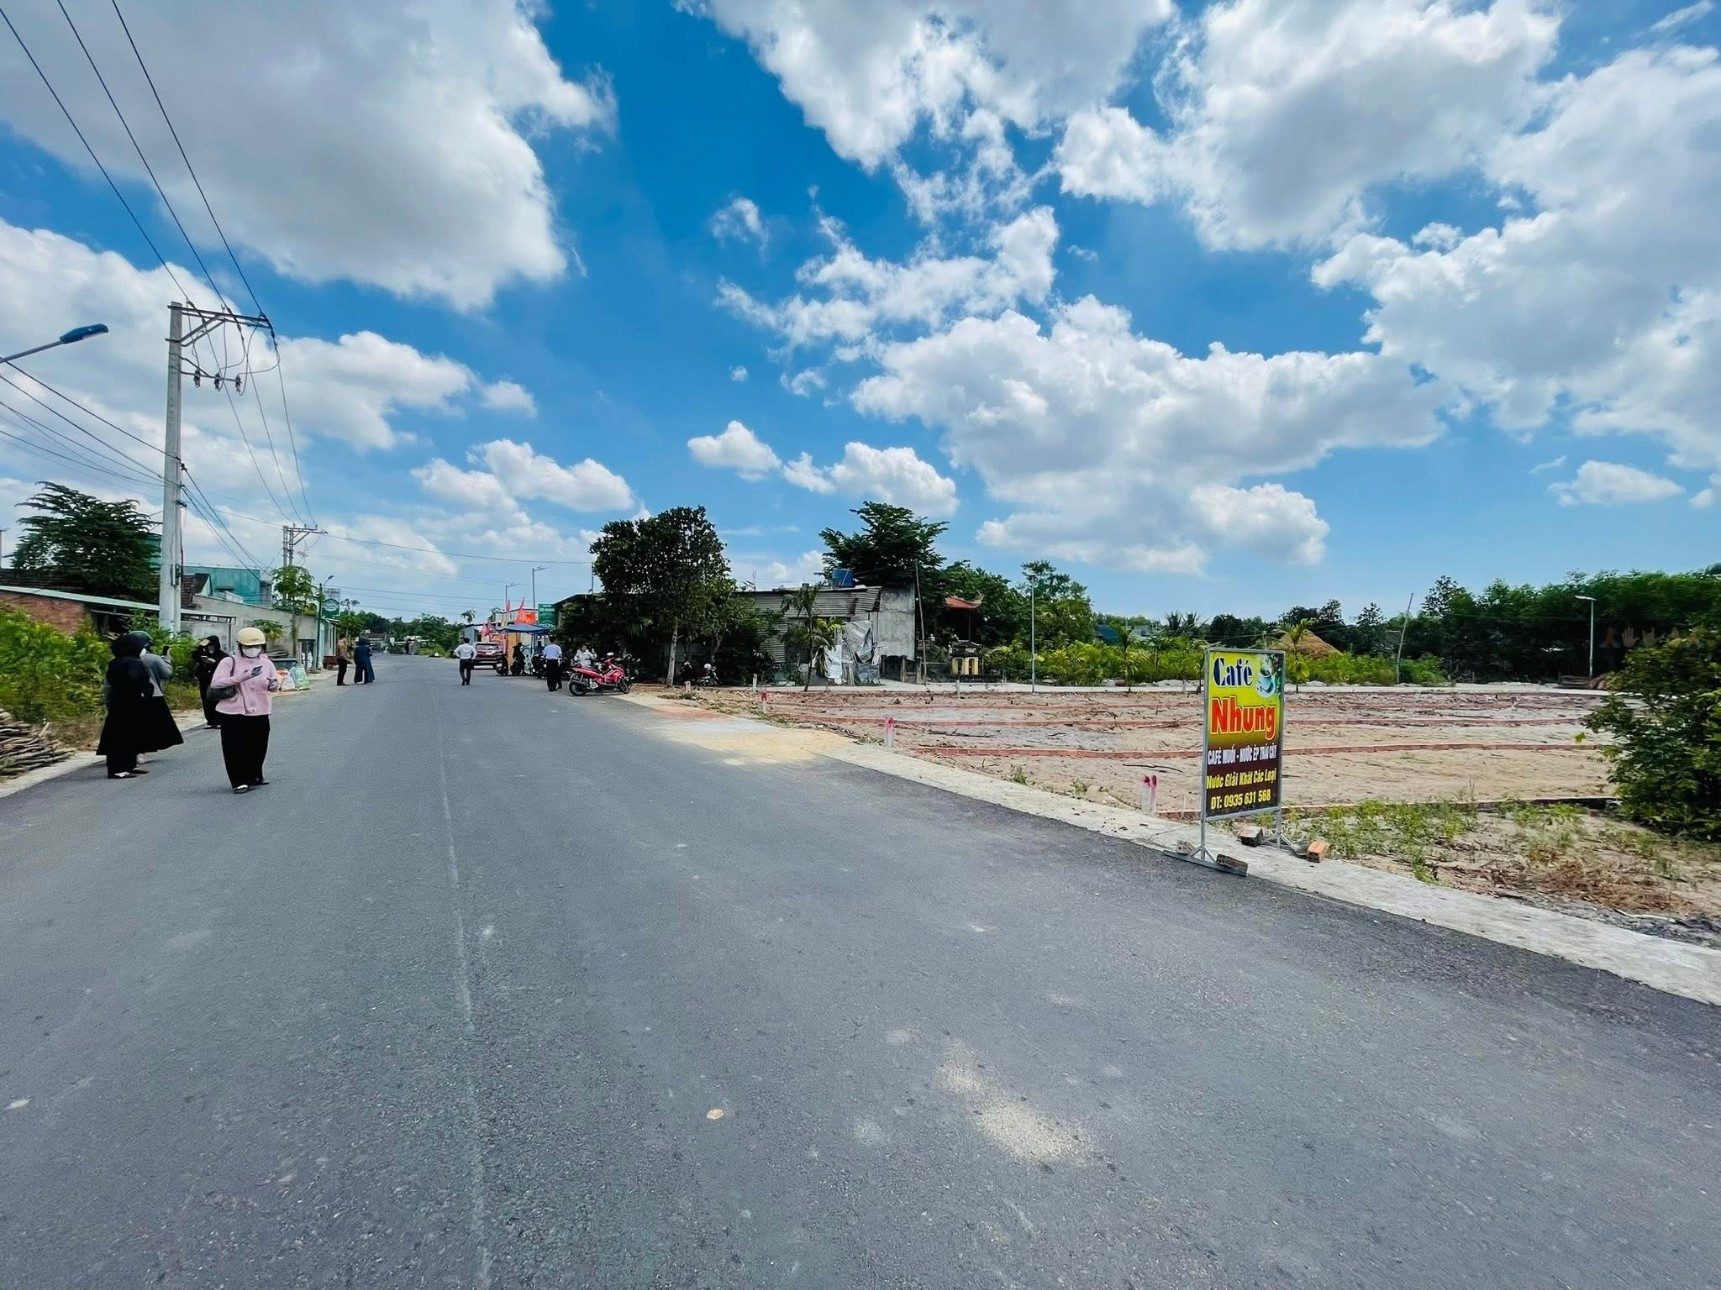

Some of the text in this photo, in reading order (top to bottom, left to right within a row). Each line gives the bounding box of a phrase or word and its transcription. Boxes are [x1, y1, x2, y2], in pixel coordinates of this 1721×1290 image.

[1213, 658, 1252, 687] Café
[1210, 696, 1276, 740] Nhung
[1223, 793, 1243, 808] 0935
[1258, 789, 1271, 802] 568
